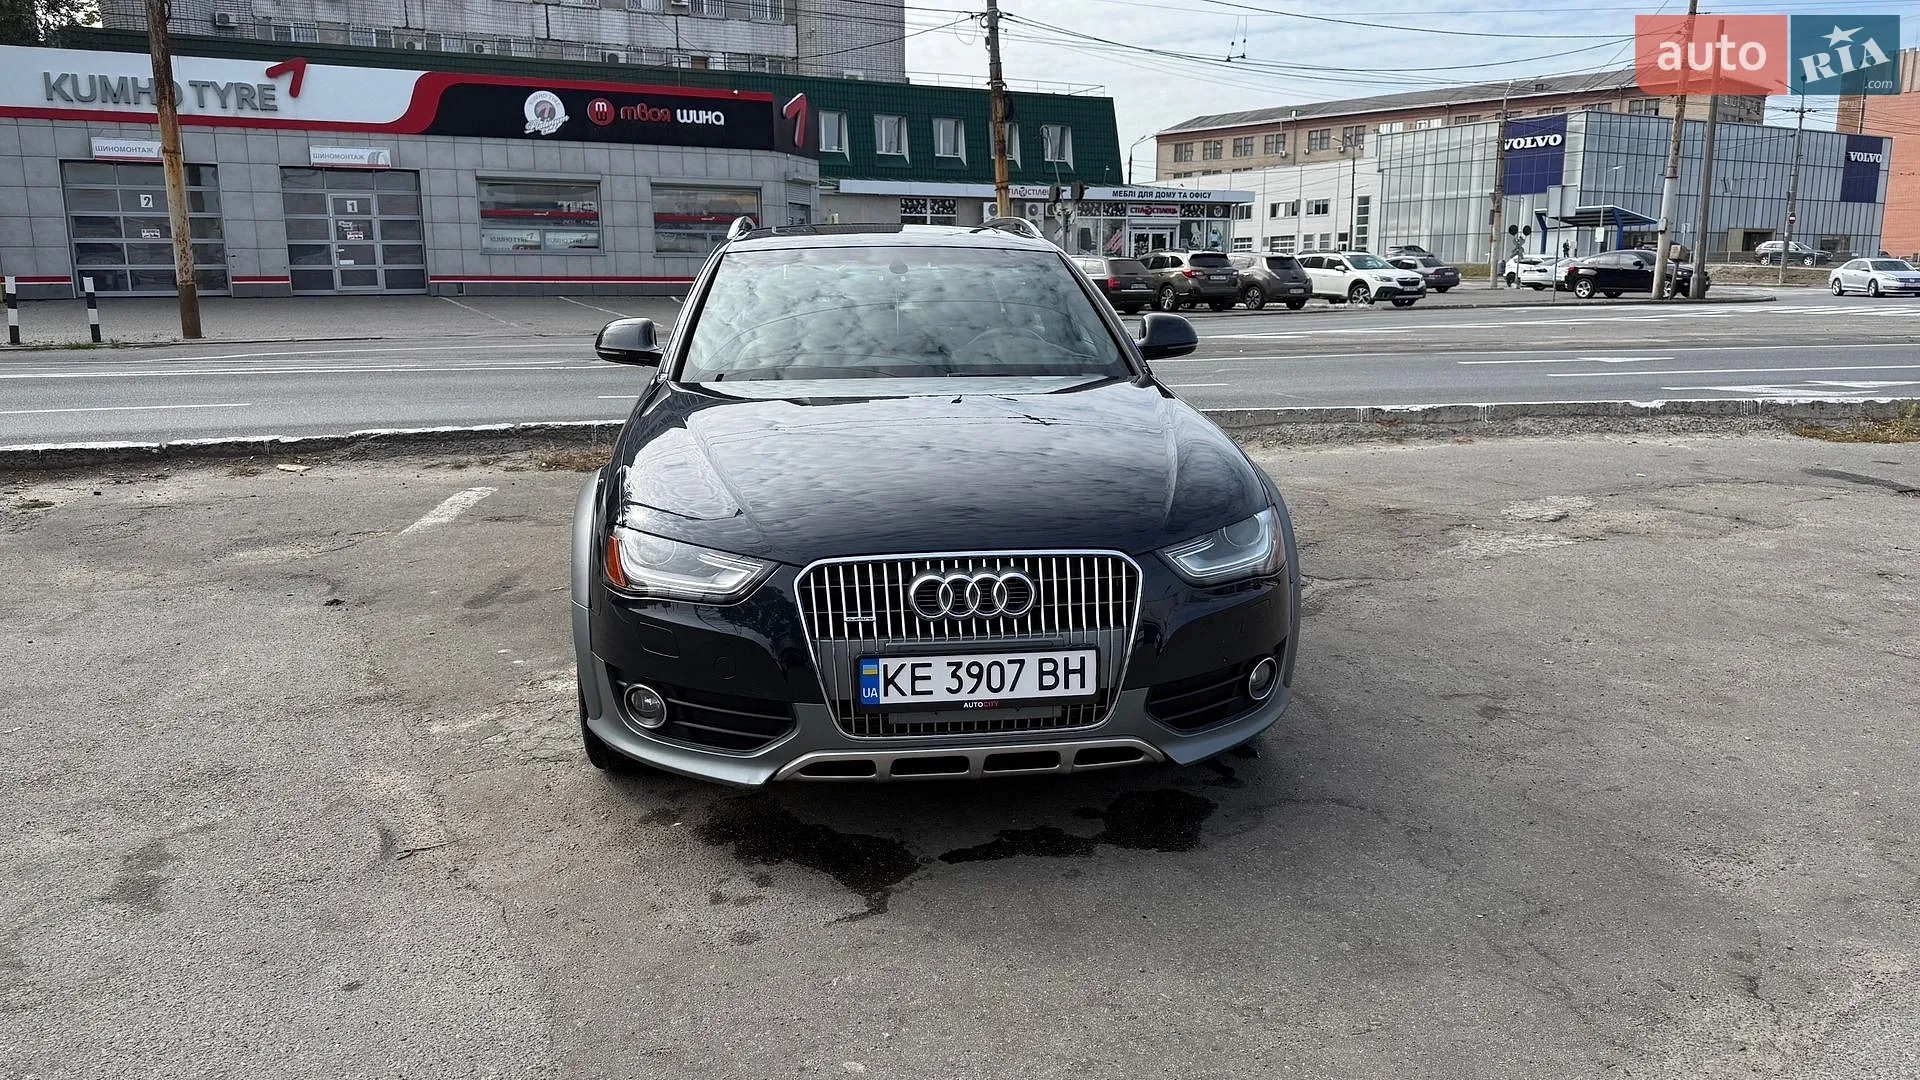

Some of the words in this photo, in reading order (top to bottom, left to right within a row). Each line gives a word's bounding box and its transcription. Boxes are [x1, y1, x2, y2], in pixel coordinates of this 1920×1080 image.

[43, 72, 183, 107] KUMH
[188, 79, 278, 112] TYRE
[620, 103, 671, 122] твоя
[676, 108, 725, 125] шина
[1504, 134, 1563, 150] VOLVO
[95, 144, 153, 153] ШИНОМОНТАЖ
[312, 152, 365, 160] ШИНОМОНТАЖ
[1848, 151, 1882, 163] VOLVO
[1112, 190, 1136, 198] МЕБЛІ
[1137, 190, 1154, 199] ДЛЯ
[1154, 191, 1177, 199] ДОМУ
[1177, 191, 1188, 199] ТА
[1189, 191, 1212, 199] ОФІСУ
[143, 196, 151, 206] 2
[882, 662, 934, 698] KE
[945, 658, 1027, 695] 3907
[1037, 656, 1086, 692] BH
[862, 687, 878, 698] UA
